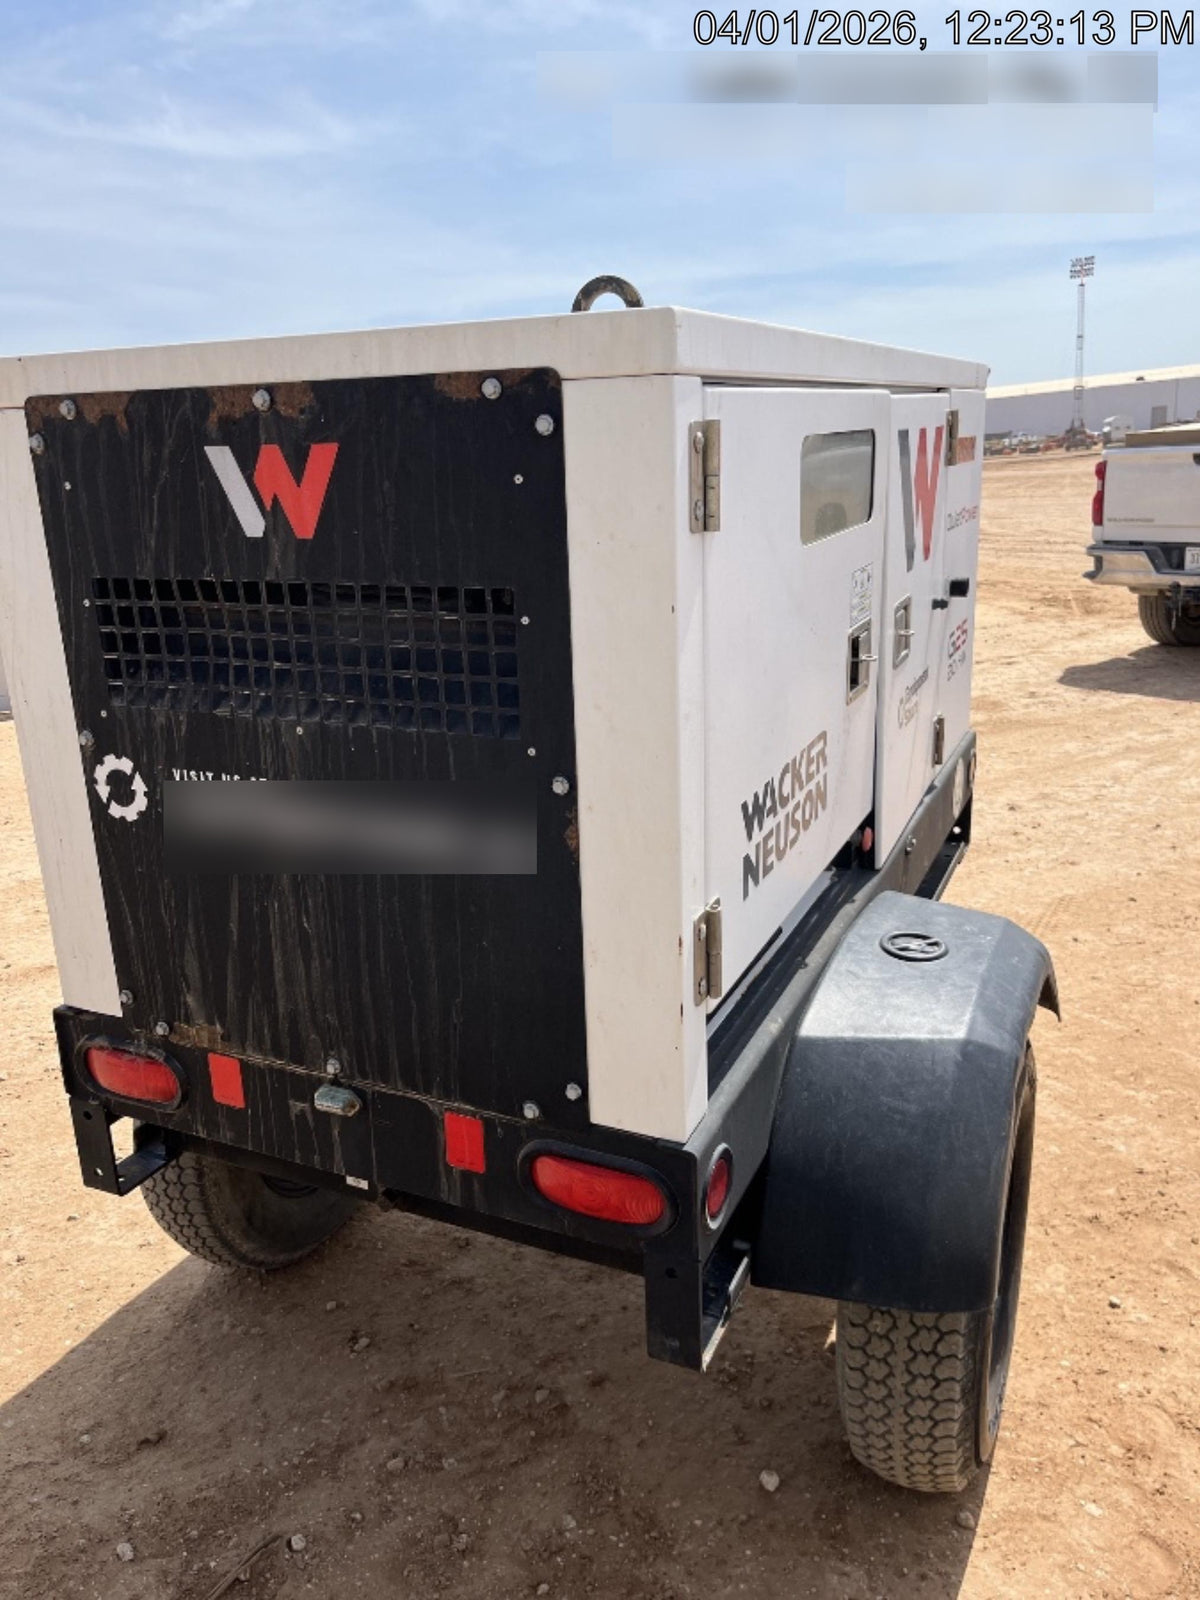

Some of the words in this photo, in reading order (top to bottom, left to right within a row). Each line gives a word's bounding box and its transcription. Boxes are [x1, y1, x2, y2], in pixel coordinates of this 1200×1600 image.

[172, 767, 214, 781] VISIT
[740, 730, 828, 842] WACKER
[741, 771, 828, 901] NEUSON
